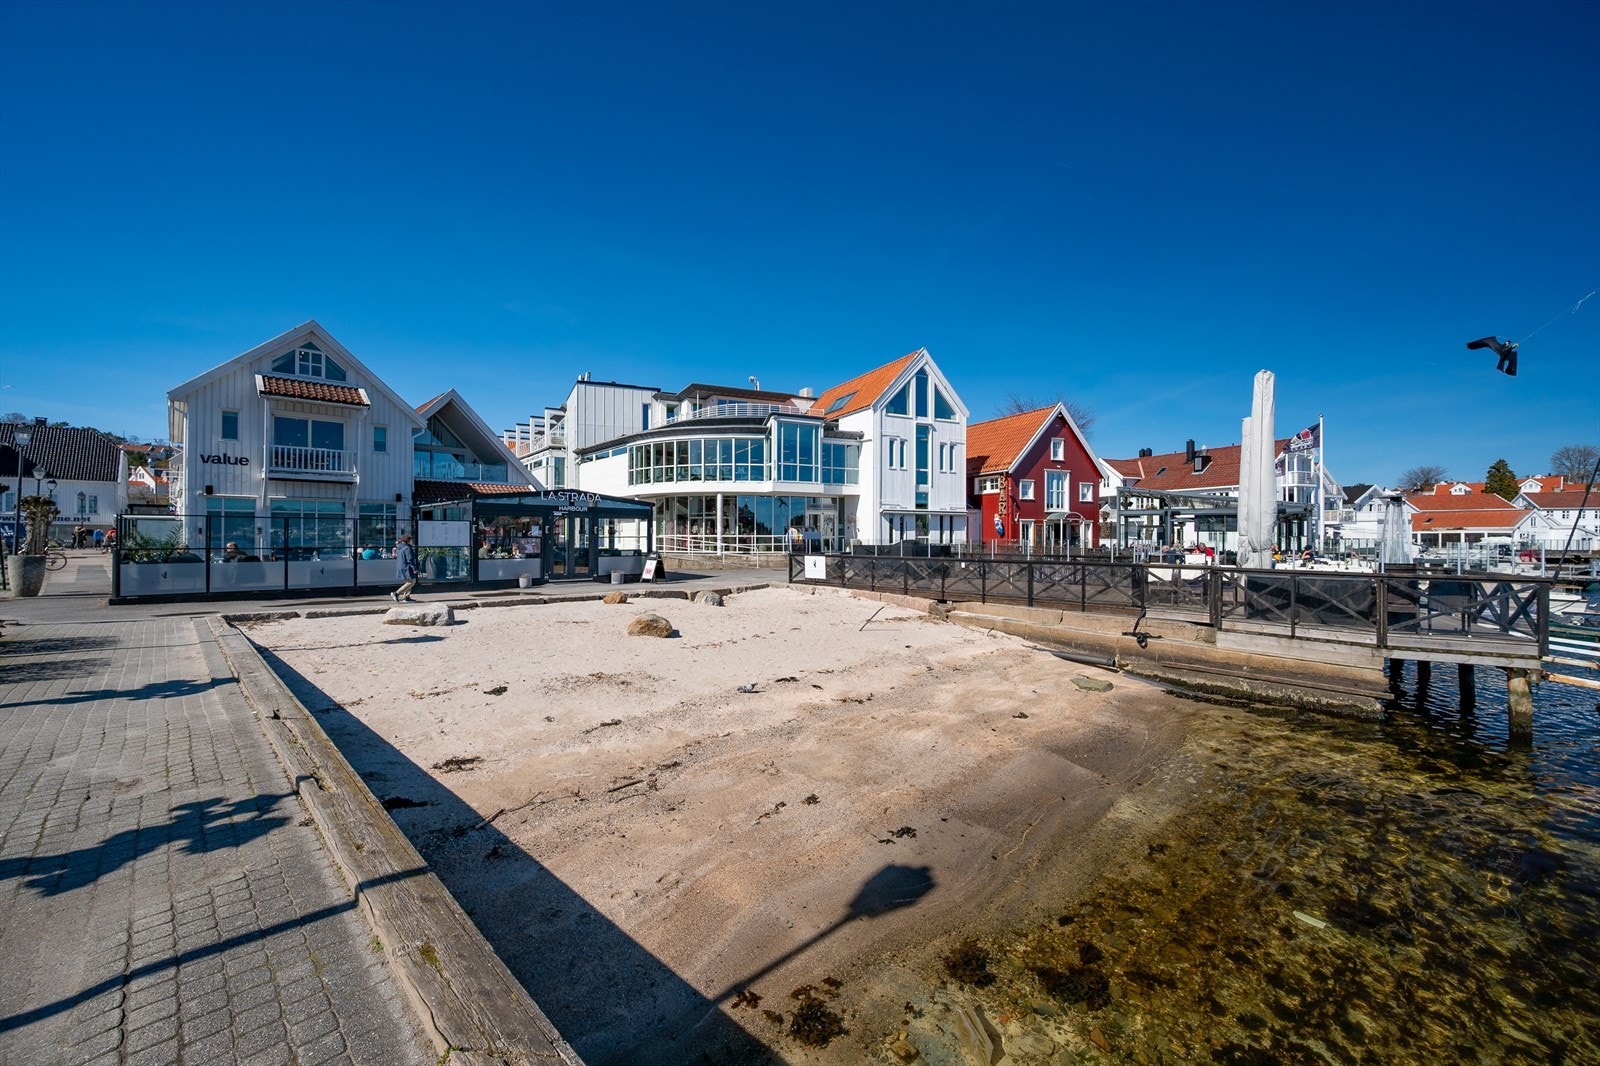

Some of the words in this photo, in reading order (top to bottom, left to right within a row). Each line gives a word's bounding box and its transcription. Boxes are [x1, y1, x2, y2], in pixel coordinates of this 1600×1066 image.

[200, 453, 249, 466] value
[540, 491, 556, 501] LA
[557, 491, 602, 503] STRADA
